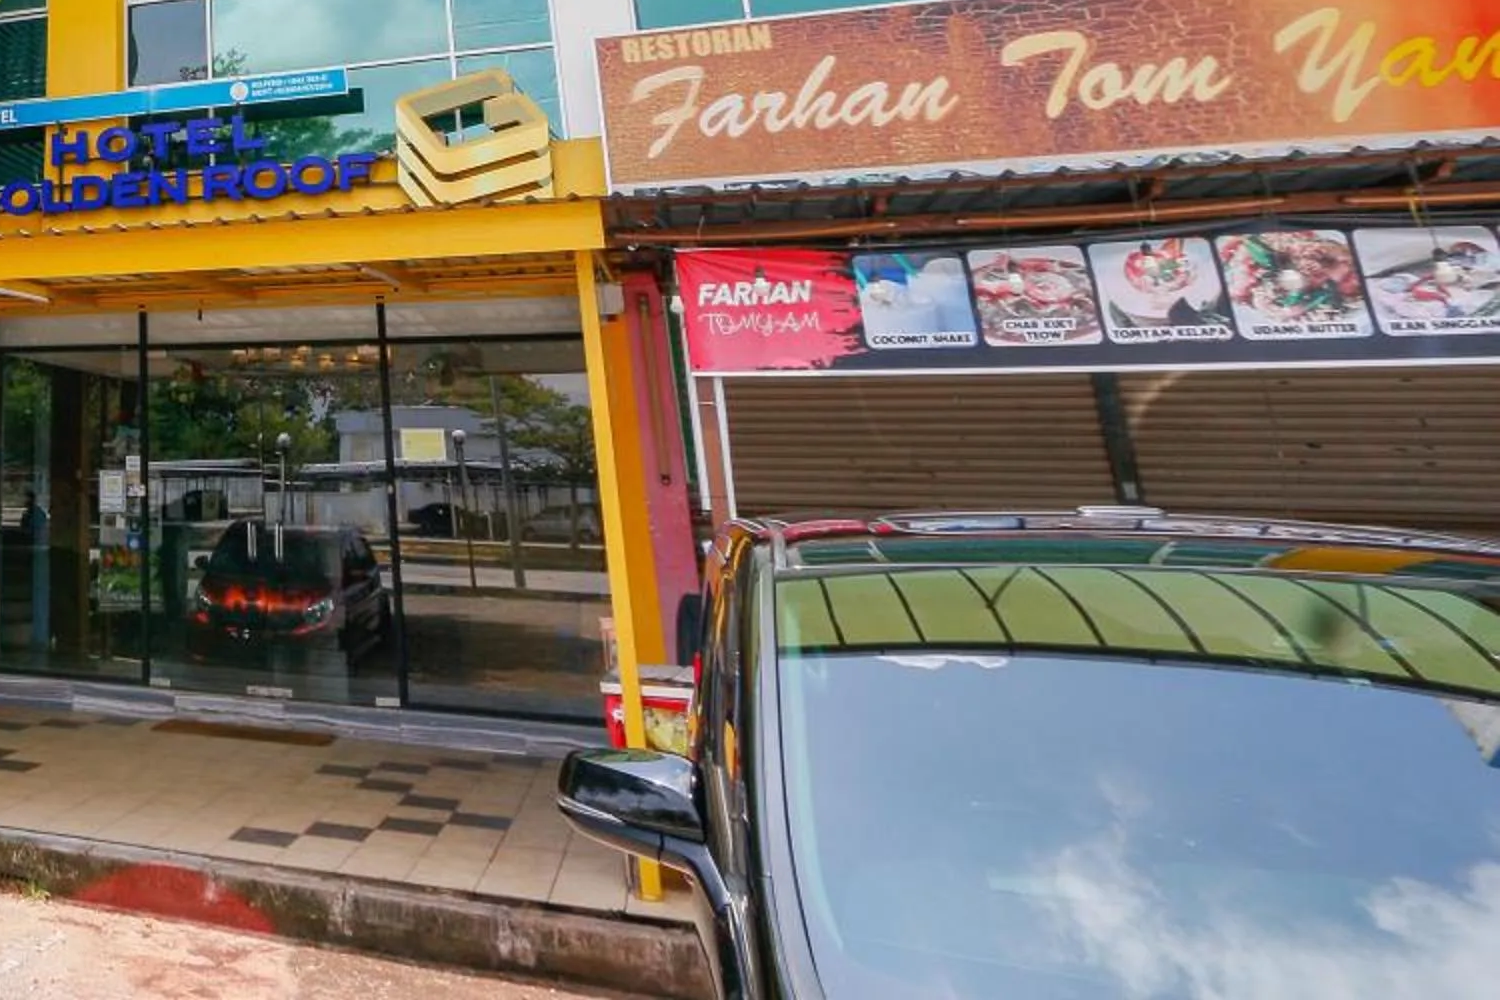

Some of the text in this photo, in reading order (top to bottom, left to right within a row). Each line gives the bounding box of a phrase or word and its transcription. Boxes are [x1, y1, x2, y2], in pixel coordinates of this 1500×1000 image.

[621, 24, 772, 63] RESTORAN
[632, 55, 959, 160] Farhan
[1001, 30, 1232, 119] Tom
[51, 115, 268, 167] HOTEL
[203, 152, 377, 201] ROOF
[872, 334, 928, 345] COCONUT
[1178, 326, 1228, 337] KELAPA
[1308, 323, 1358, 334] BUTTER
